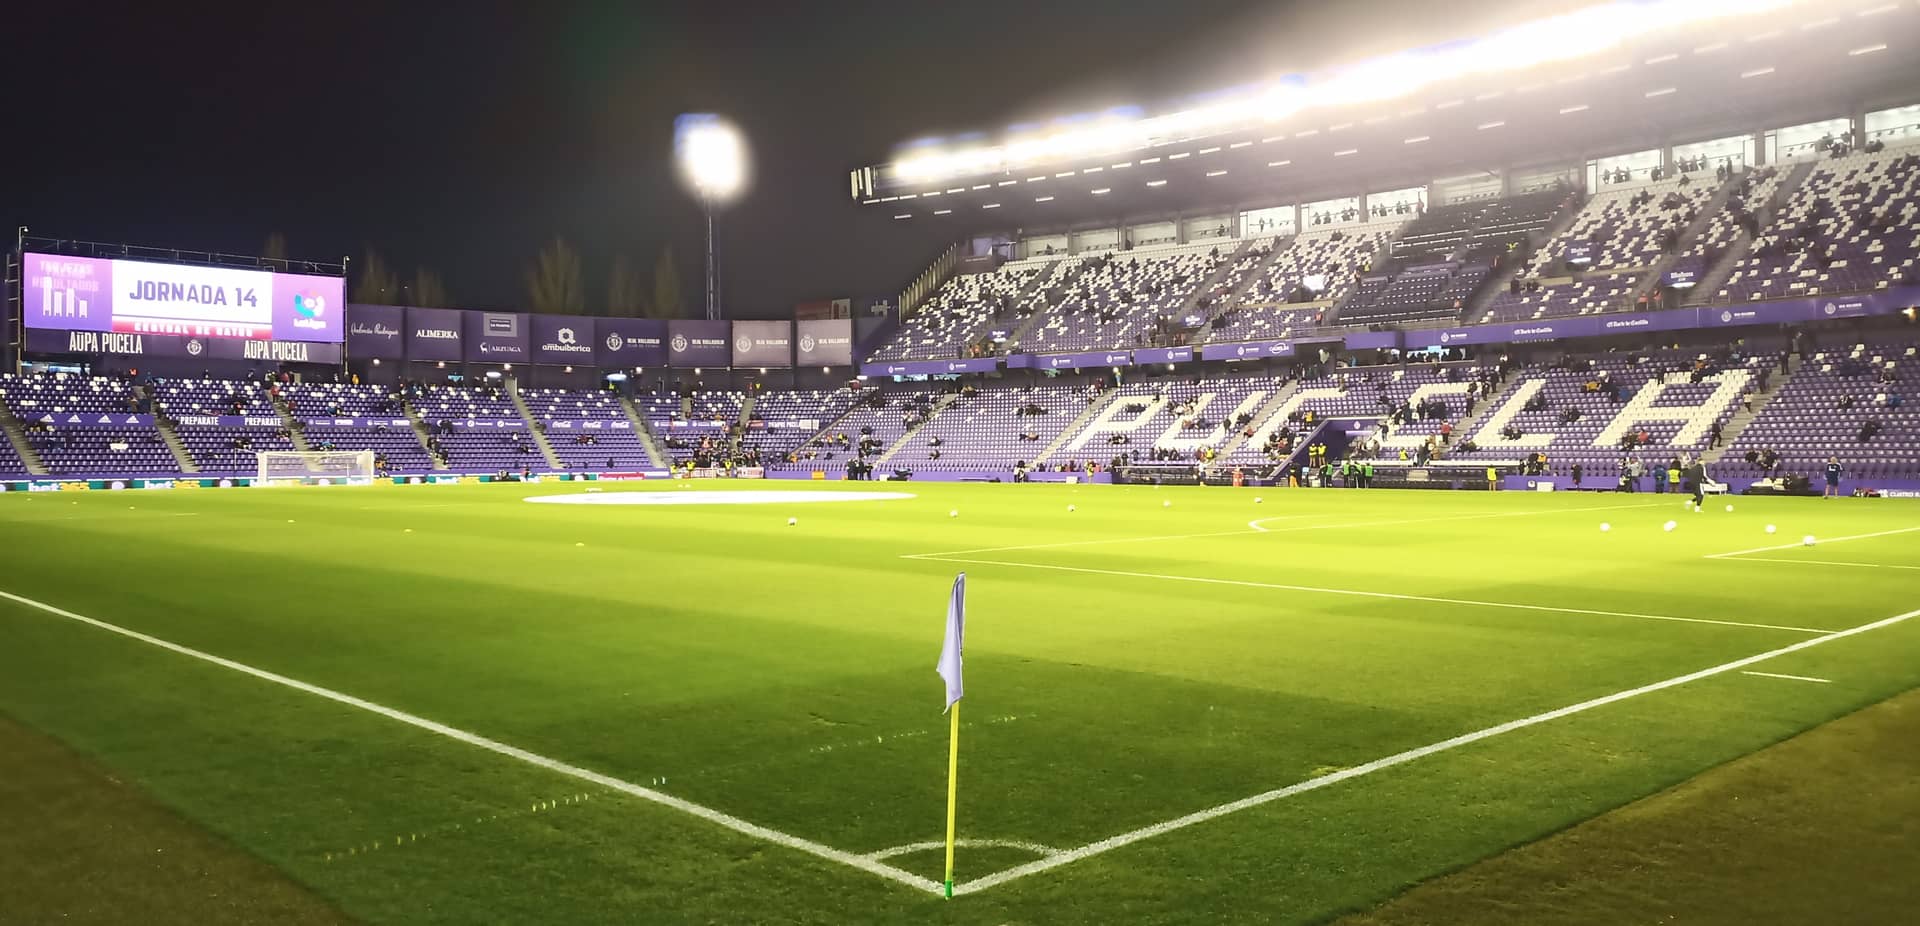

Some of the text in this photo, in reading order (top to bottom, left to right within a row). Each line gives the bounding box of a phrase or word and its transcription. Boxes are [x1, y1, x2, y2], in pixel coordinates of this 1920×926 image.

[129, 280, 258, 307] JORNADA 14
[415, 329, 459, 340] ALIMERKA
[102, 333, 143, 355] PUCELA
[272, 341, 308, 361] PUCELA
[180, 416, 219, 425] PREPARATE
[244, 417, 282, 426] PREPARATE
[29, 482, 90, 492] bet365
[144, 479, 201, 489] bet365
